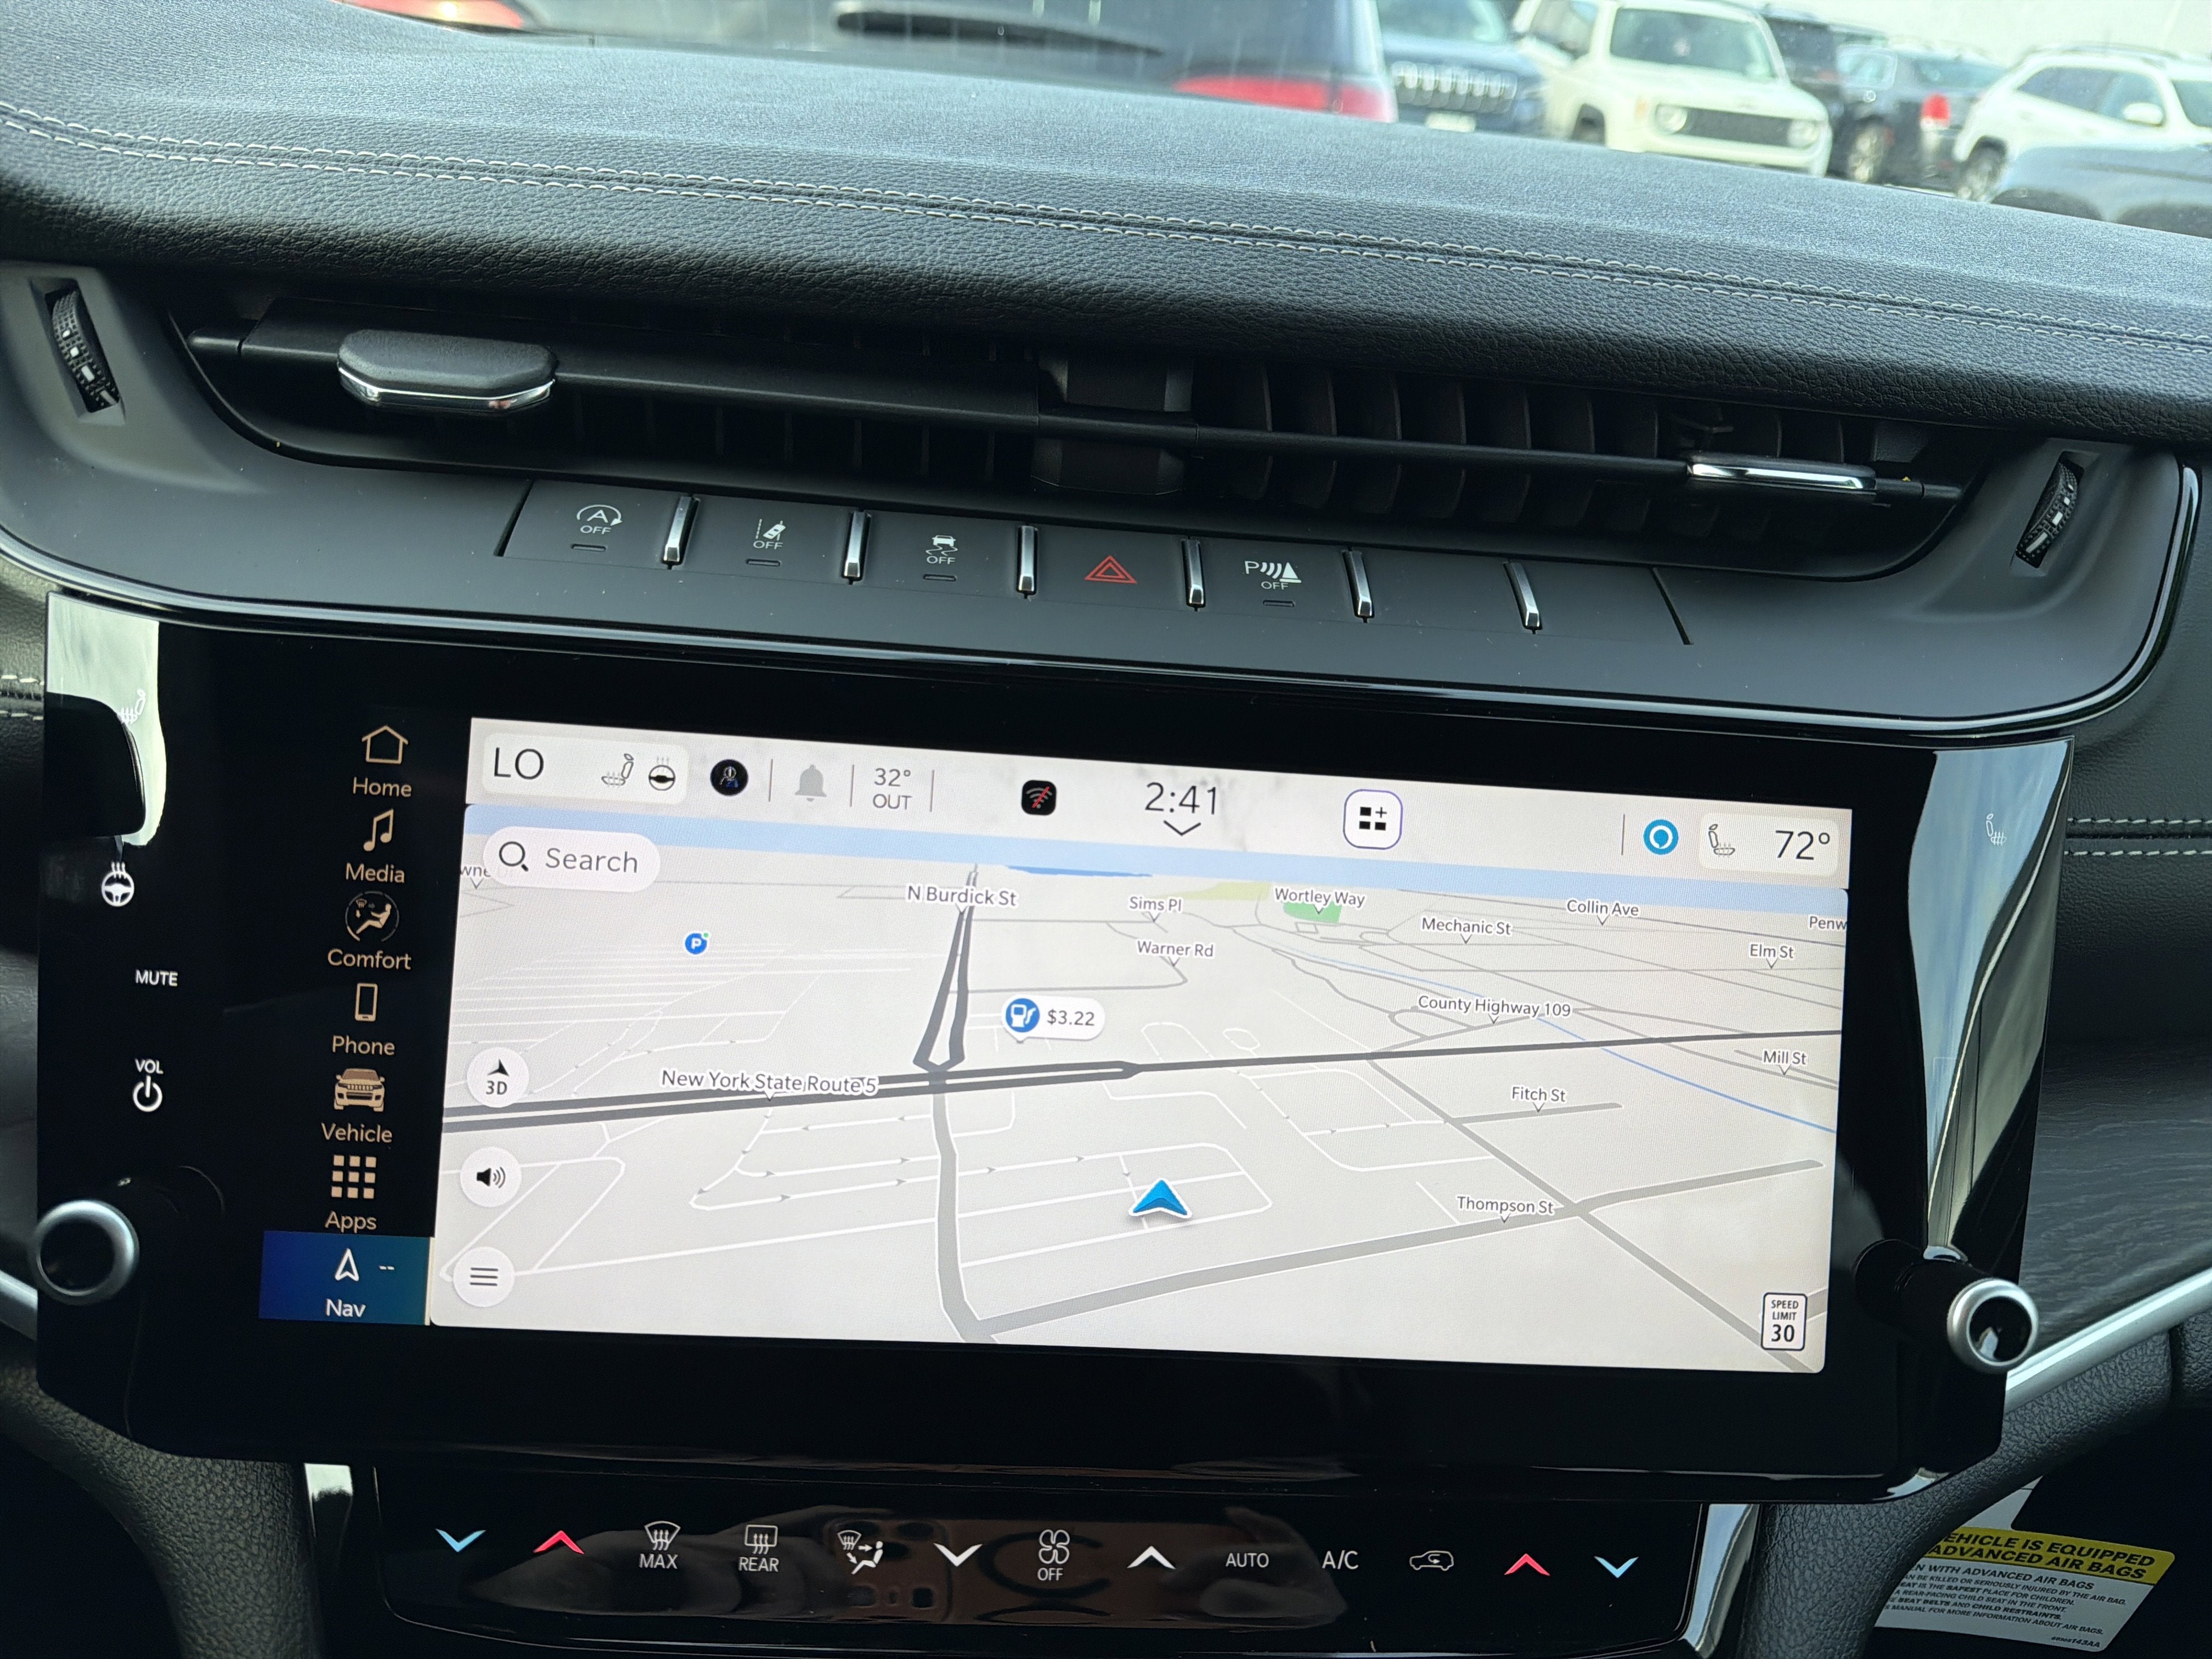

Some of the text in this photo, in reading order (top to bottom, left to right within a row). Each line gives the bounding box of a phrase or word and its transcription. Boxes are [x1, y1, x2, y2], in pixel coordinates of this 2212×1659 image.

[580, 525, 611, 535] OFF
[753, 540, 783, 550] OFF
[926, 556, 957, 565] OFF
[1261, 581, 1289, 590] OFF
[493, 747, 544, 780] LO
[873, 768, 912, 787] 32°
[352, 777, 412, 798] Home
[873, 793, 912, 810] OUT
[1145, 782, 1217, 815] 2:41
[1775, 830, 1831, 860] 72°
[545, 847, 639, 874] Search
[345, 862, 406, 883] Media
[907, 885, 1017, 907] N Burdick St
[1129, 896, 1182, 912] Sims Pl
[1274, 887, 1365, 908] Wortley Way
[1567, 899, 1639, 916] Collin Ave
[1422, 917, 1511, 935] Mechanic St
[1137, 940, 1214, 957] Warner Rd
[1750, 944, 1794, 959] Elm St
[327, 949, 411, 970] Comfort
[135, 969, 178, 986] MUTE
[1418, 996, 1571, 1018] County Highway 109
[1047, 1009, 1095, 1027] $3.22
[331, 1036, 396, 1056] Phone
[135, 1059, 163, 1074] VOL
[1763, 1050, 1807, 1066] Mill St
[486, 1080, 508, 1096] 3D
[661, 1070, 876, 1094] New York State Route 5
[1511, 1086, 1566, 1102] Fitch St
[321, 1122, 392, 1143] Vehicle
[1457, 1195, 1554, 1215] Thompson St
[325, 1211, 377, 1232] Apps
[325, 1299, 366, 1318] Nav
[1771, 1299, 1799, 1310] SPEED
[1772, 1310, 1797, 1321] LIMIT
[1770, 1324, 1796, 1344] 30
[1944, 1533, 2155, 1567] EHICLE IS EQUIPPED
[639, 1553, 679, 1570] MAX
[738, 1556, 779, 1573] REAR
[1225, 1553, 1269, 1568] AUTO
[1323, 1549, 1359, 1570] A/C
[1927, 1544, 2147, 1579] ADVANCED AIR BAGS
[1037, 1566, 1064, 1581] OFF
[1928, 1565, 1961, 1573] WITH
[1962, 1568, 2033, 1581] ADVANCED
[2034, 1576, 2057, 1585] AIR
[2058, 1579, 2095, 1590] BAGS
[1903, 1590, 1957, 1599] REAR-FACING
[1946, 1585, 1982, 1593] SAFEST
[1982, 1588, 2010, 1596] PLACE
[2030, 1594, 2075, 1606] CHILDREN.
[1974, 1579, 2021, 1589] SERIOUSLY
[2022, 1585, 2057, 1594] INJURED
[1972, 1611, 2032, 1623] INFORMATION
[2032, 1619, 2063, 1628] ABOUT
